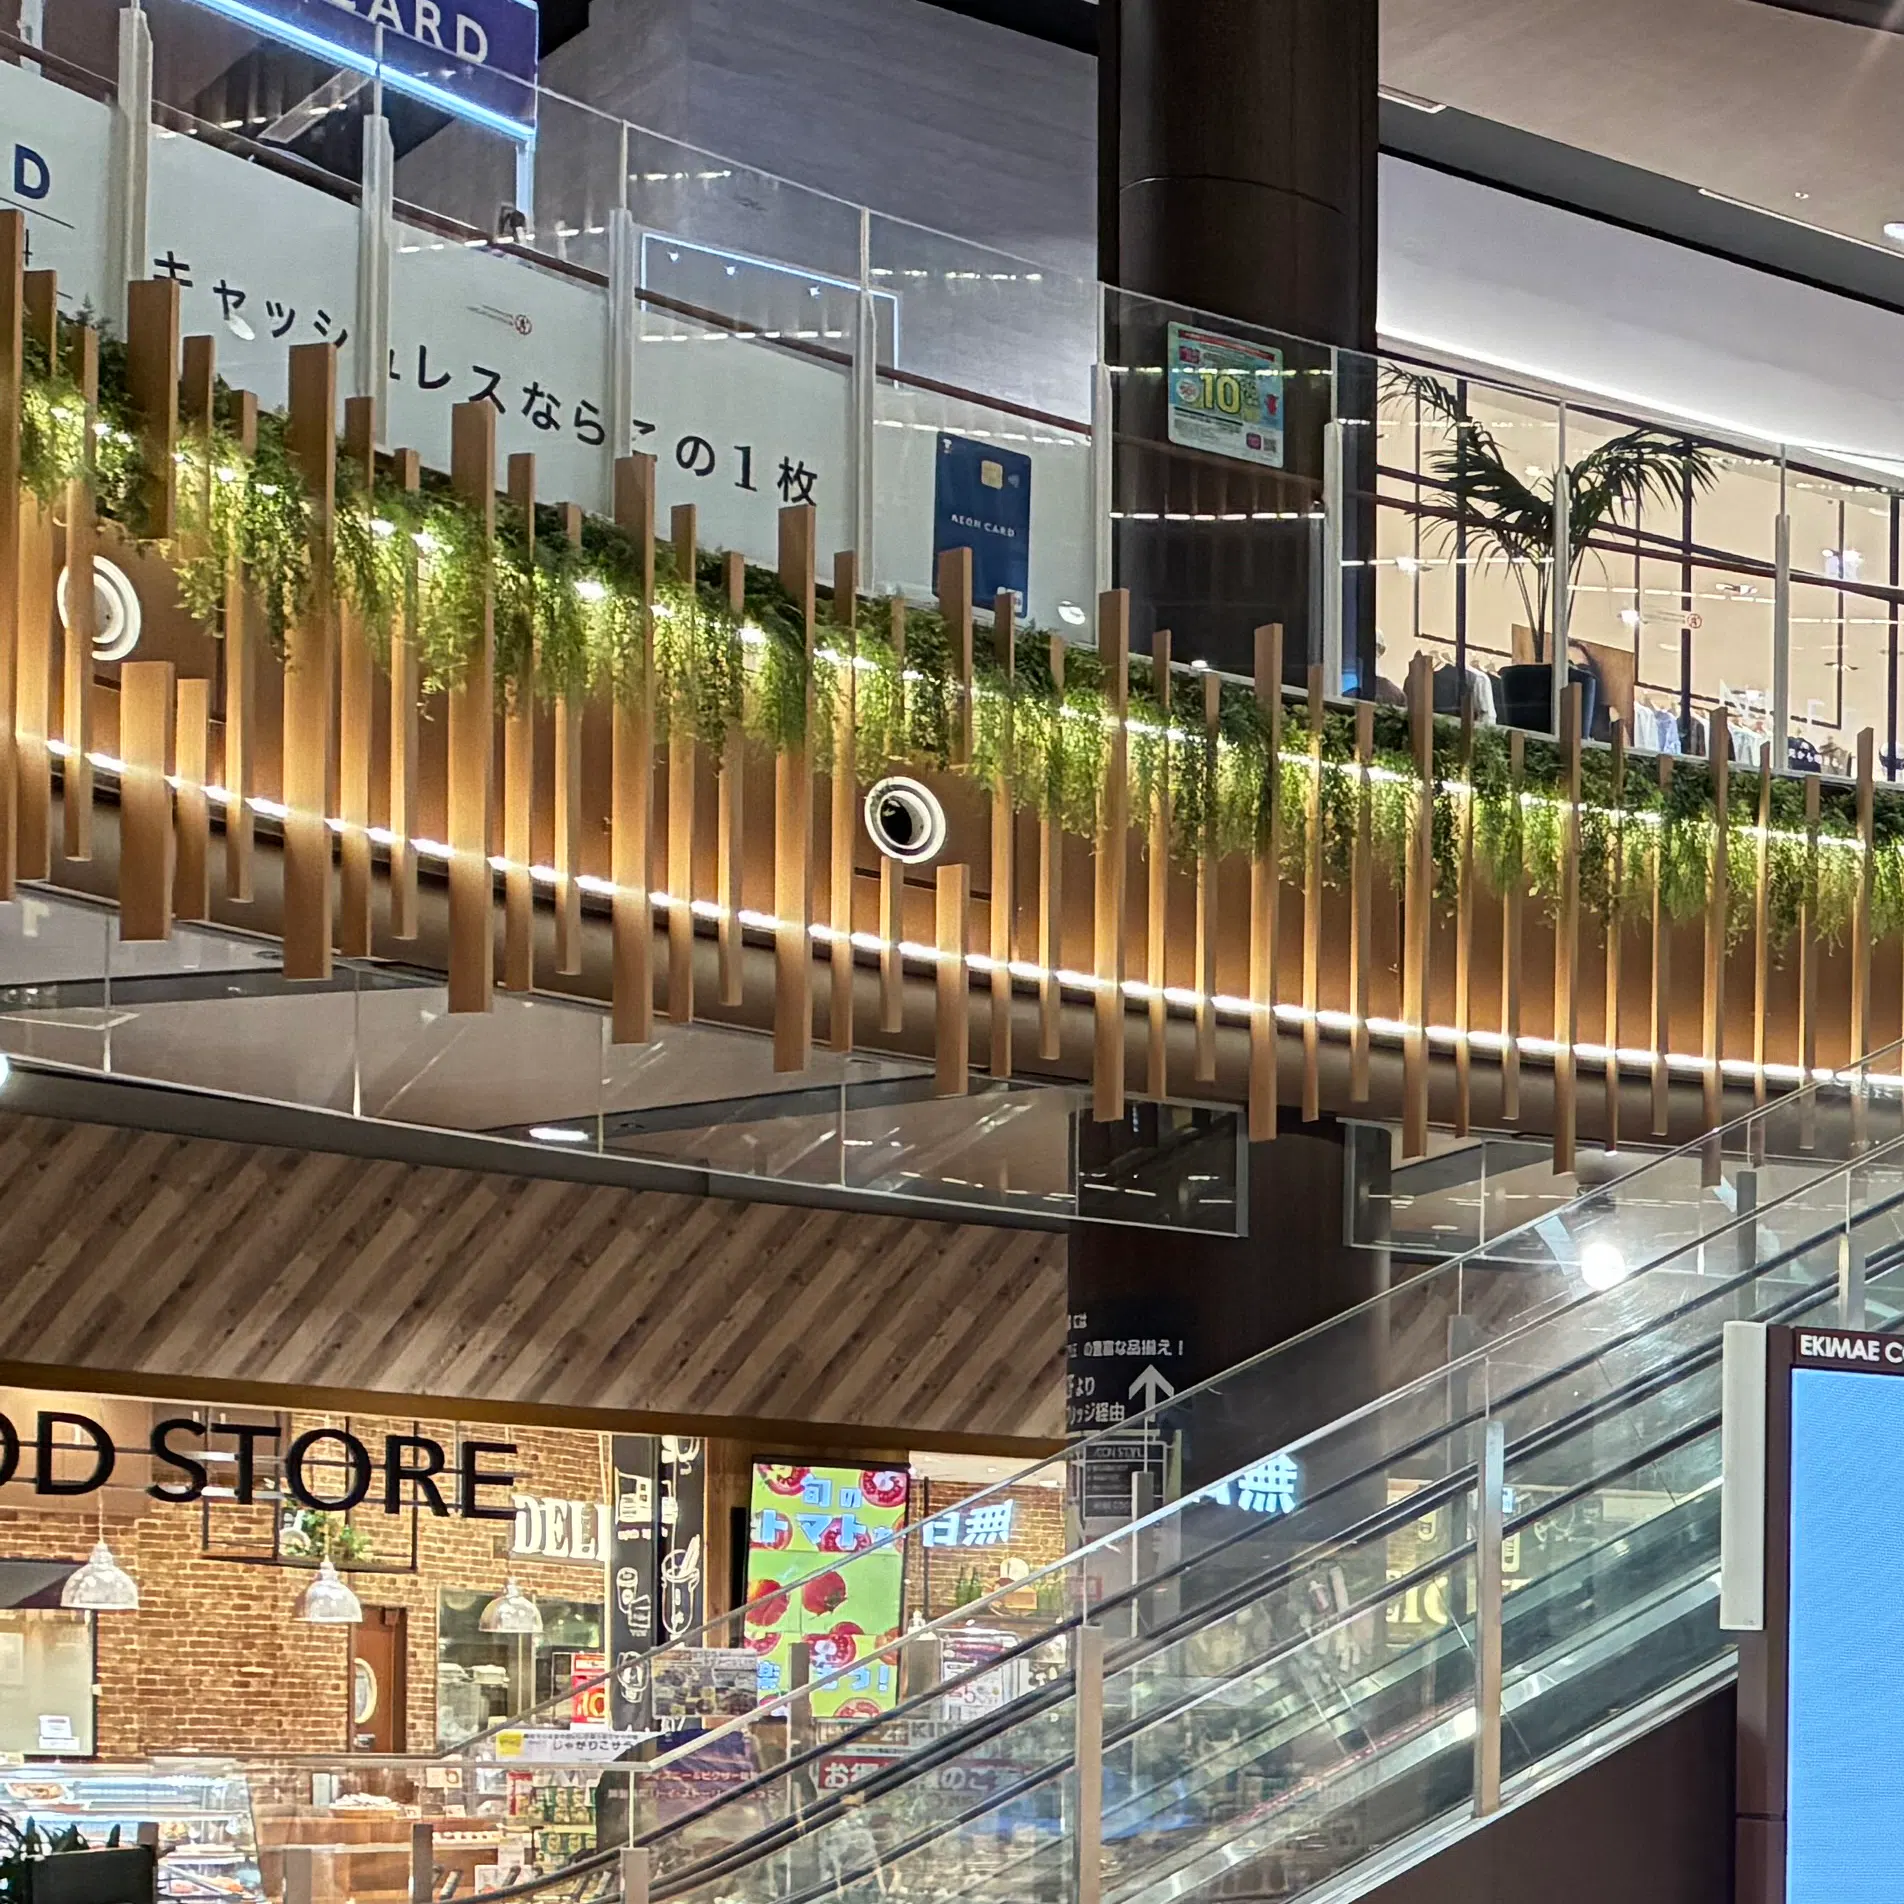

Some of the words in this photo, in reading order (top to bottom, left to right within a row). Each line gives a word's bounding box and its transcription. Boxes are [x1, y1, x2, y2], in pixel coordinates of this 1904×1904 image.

[152, 250, 819, 507] キャッシレスならの1枚
[984, 522, 1015, 538] CARD
[1800, 1335, 1880, 1362] EKIMAE
[148, 1418, 518, 1520] STORE
[800, 1474, 862, 1508] 旬の
